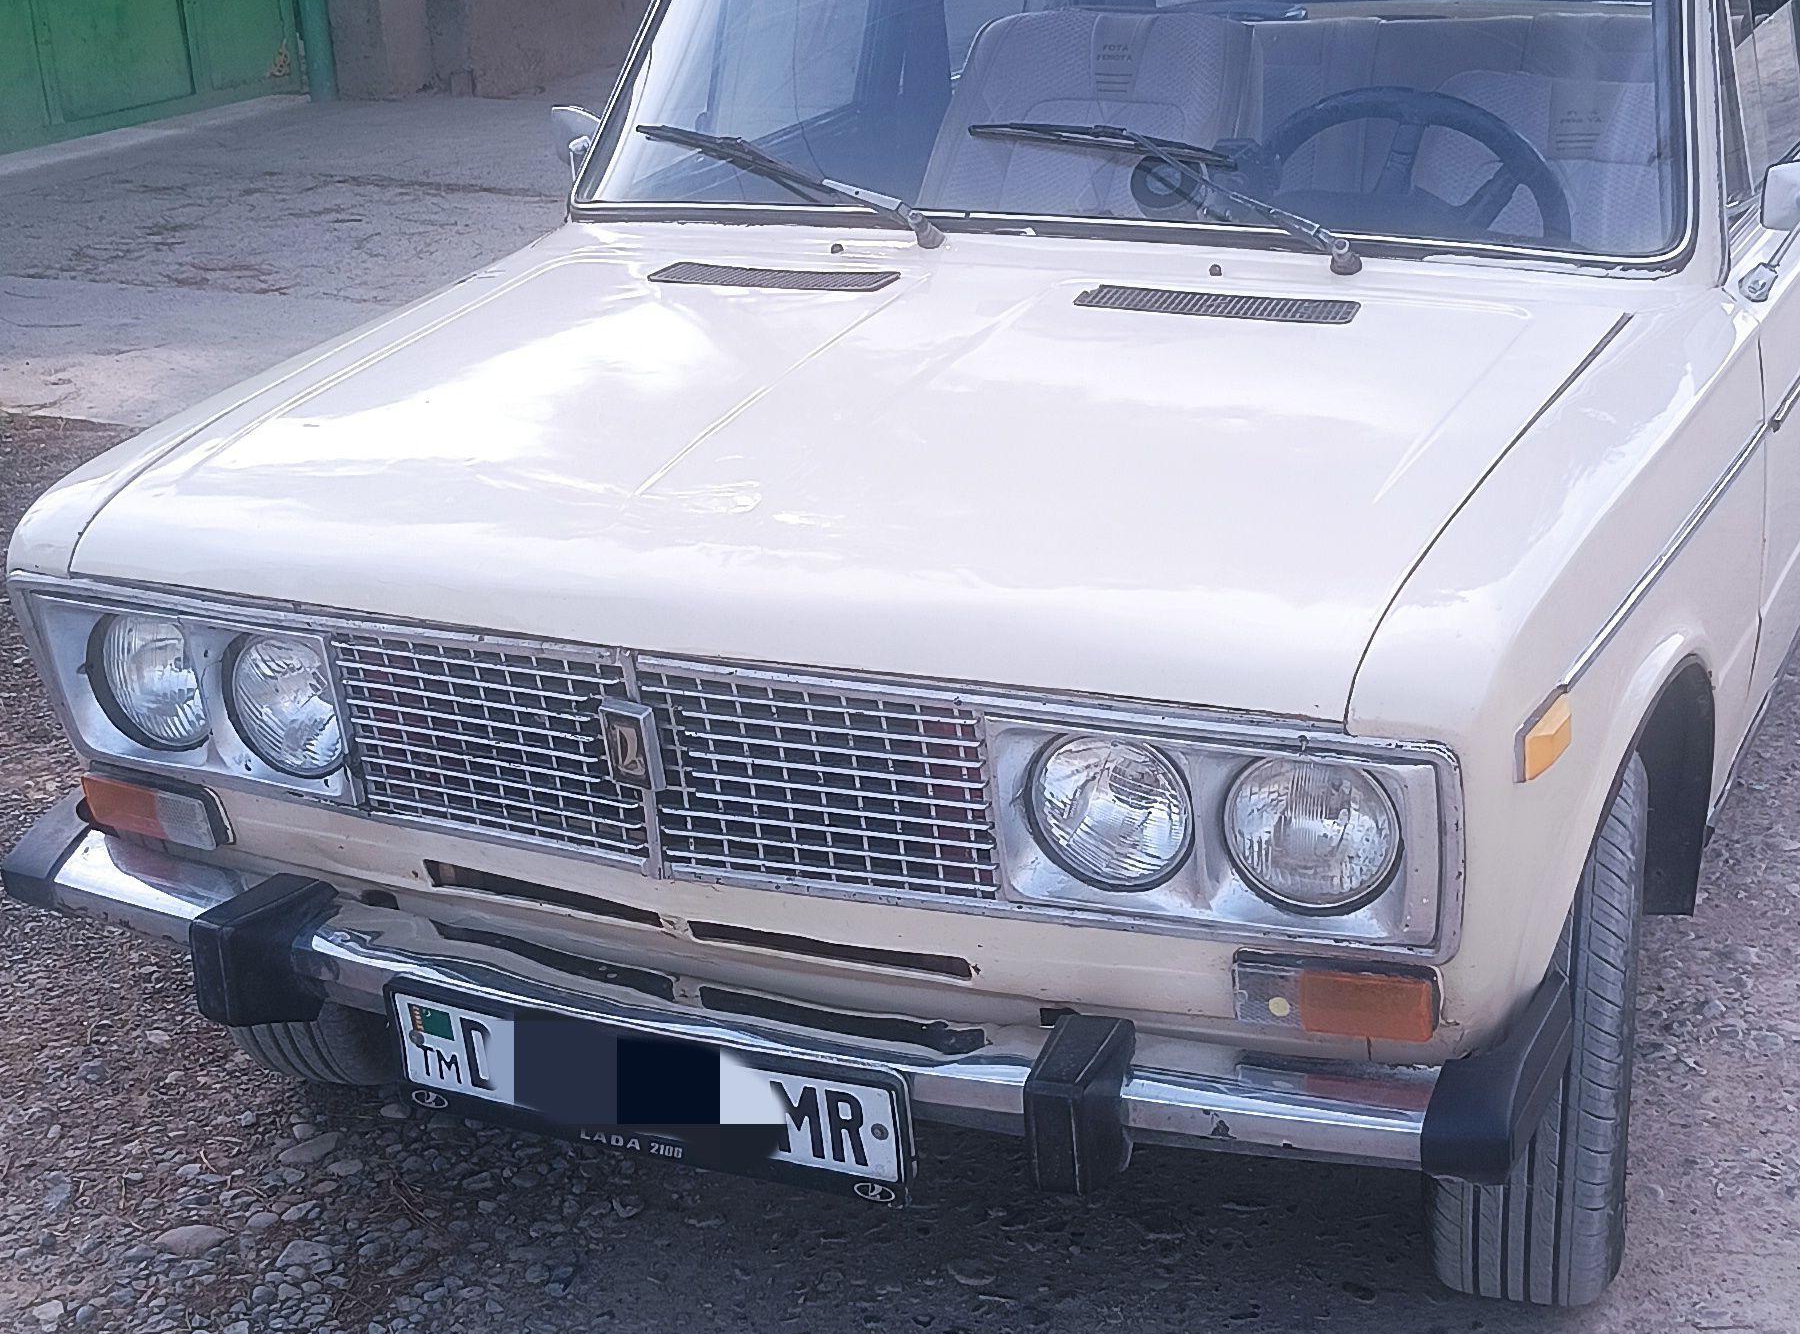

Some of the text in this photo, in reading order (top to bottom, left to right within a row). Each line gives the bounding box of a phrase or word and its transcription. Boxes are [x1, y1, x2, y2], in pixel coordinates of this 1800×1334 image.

[416, 1044, 462, 1085] TM
[580, 1129, 641, 1151] LADA
[770, 1080, 869, 1167] MR
